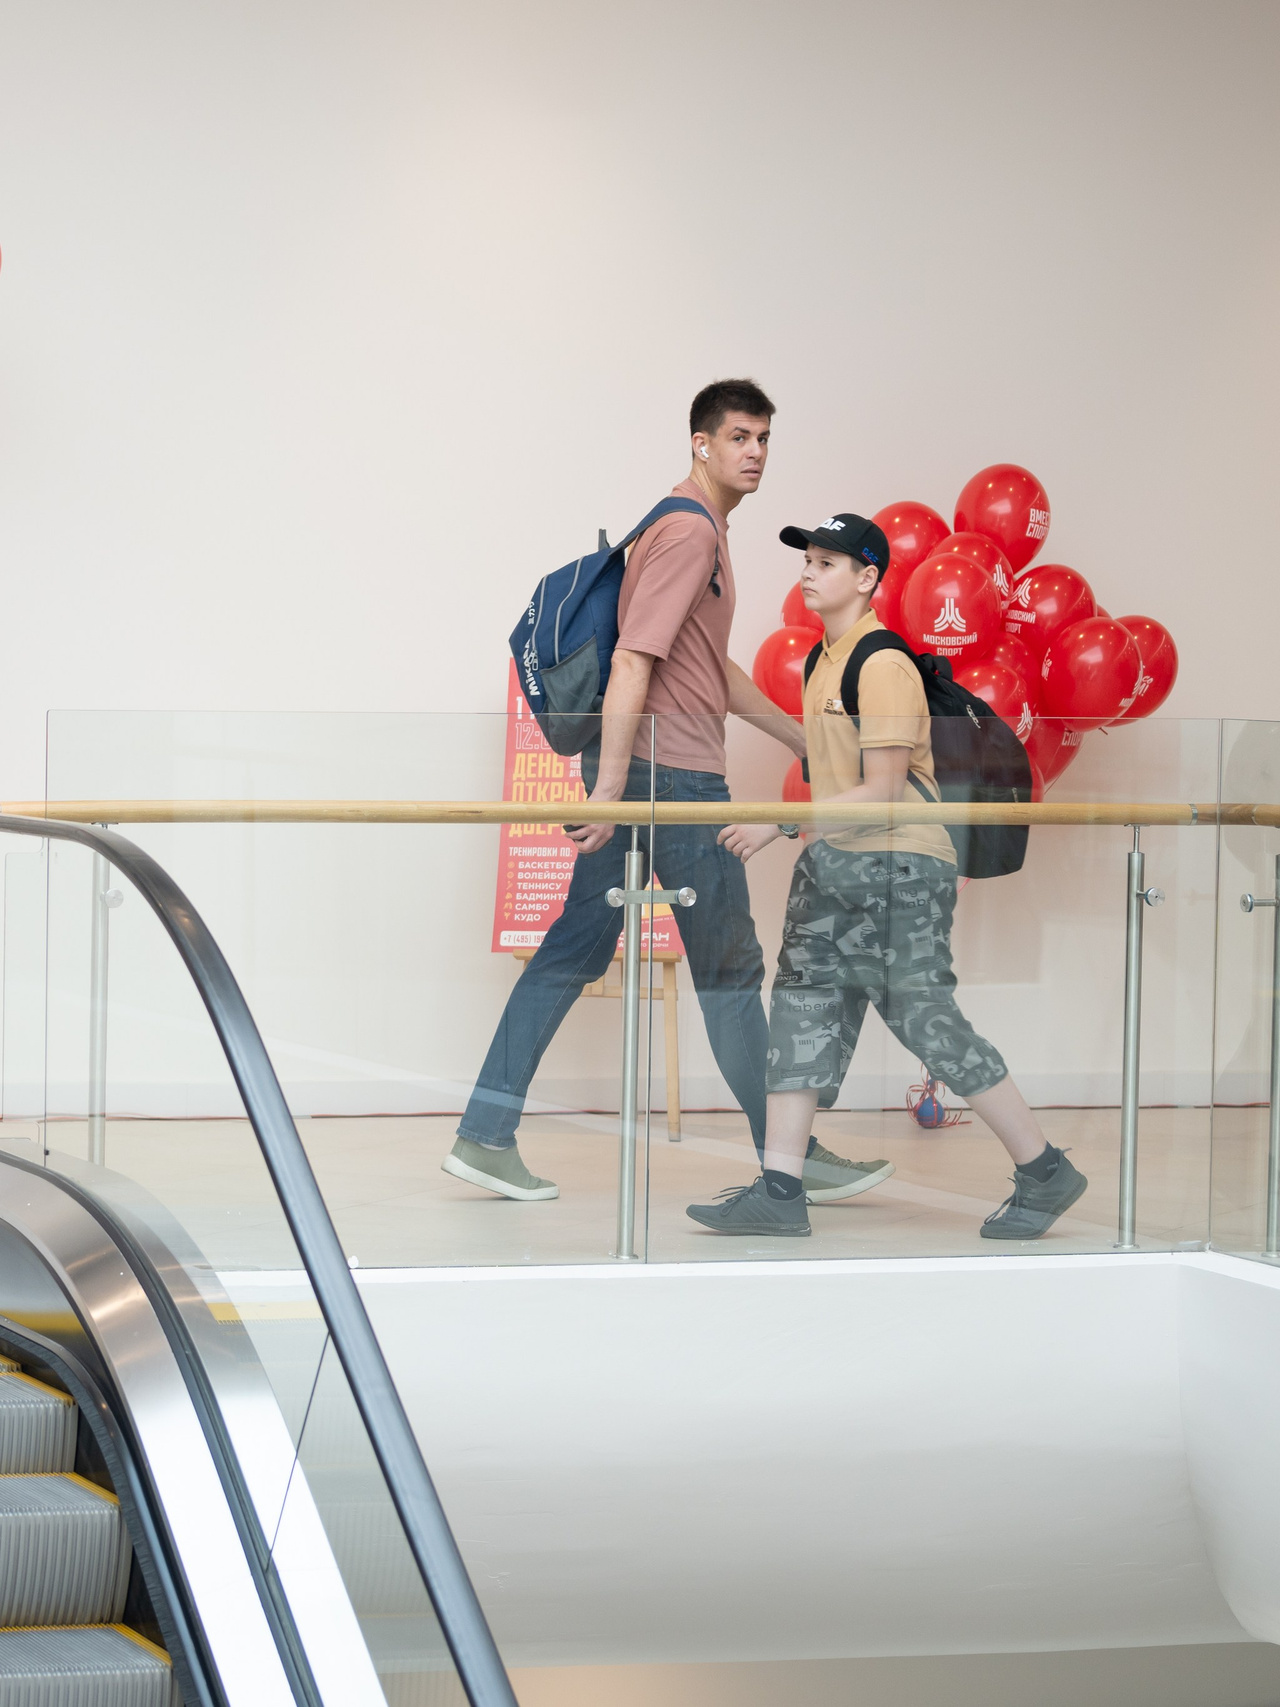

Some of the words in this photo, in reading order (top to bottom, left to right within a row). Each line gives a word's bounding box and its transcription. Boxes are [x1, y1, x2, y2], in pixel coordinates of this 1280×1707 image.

[819, 517, 846, 531] AF
[922, 632, 978, 646] МОСКОВСКИЙ
[936, 647, 964, 657] СПОРТ
[512, 752, 565, 781] ДЕНЬ
[509, 846, 558, 857] ТРЕНИРОВКИ
[559, 847, 573, 857] ПО:
[518, 861, 575, 869] БАСКЕТБОЛ
[517, 870, 573, 880] ВОЛЕЙБОЛ
[517, 882, 562, 890] ТЕННИСУ
[515, 892, 568, 901] БАДМИНТО
[515, 903, 550, 911] САМБО
[514, 913, 541, 922] КУДО
[513, 934, 532, 945] (495)
